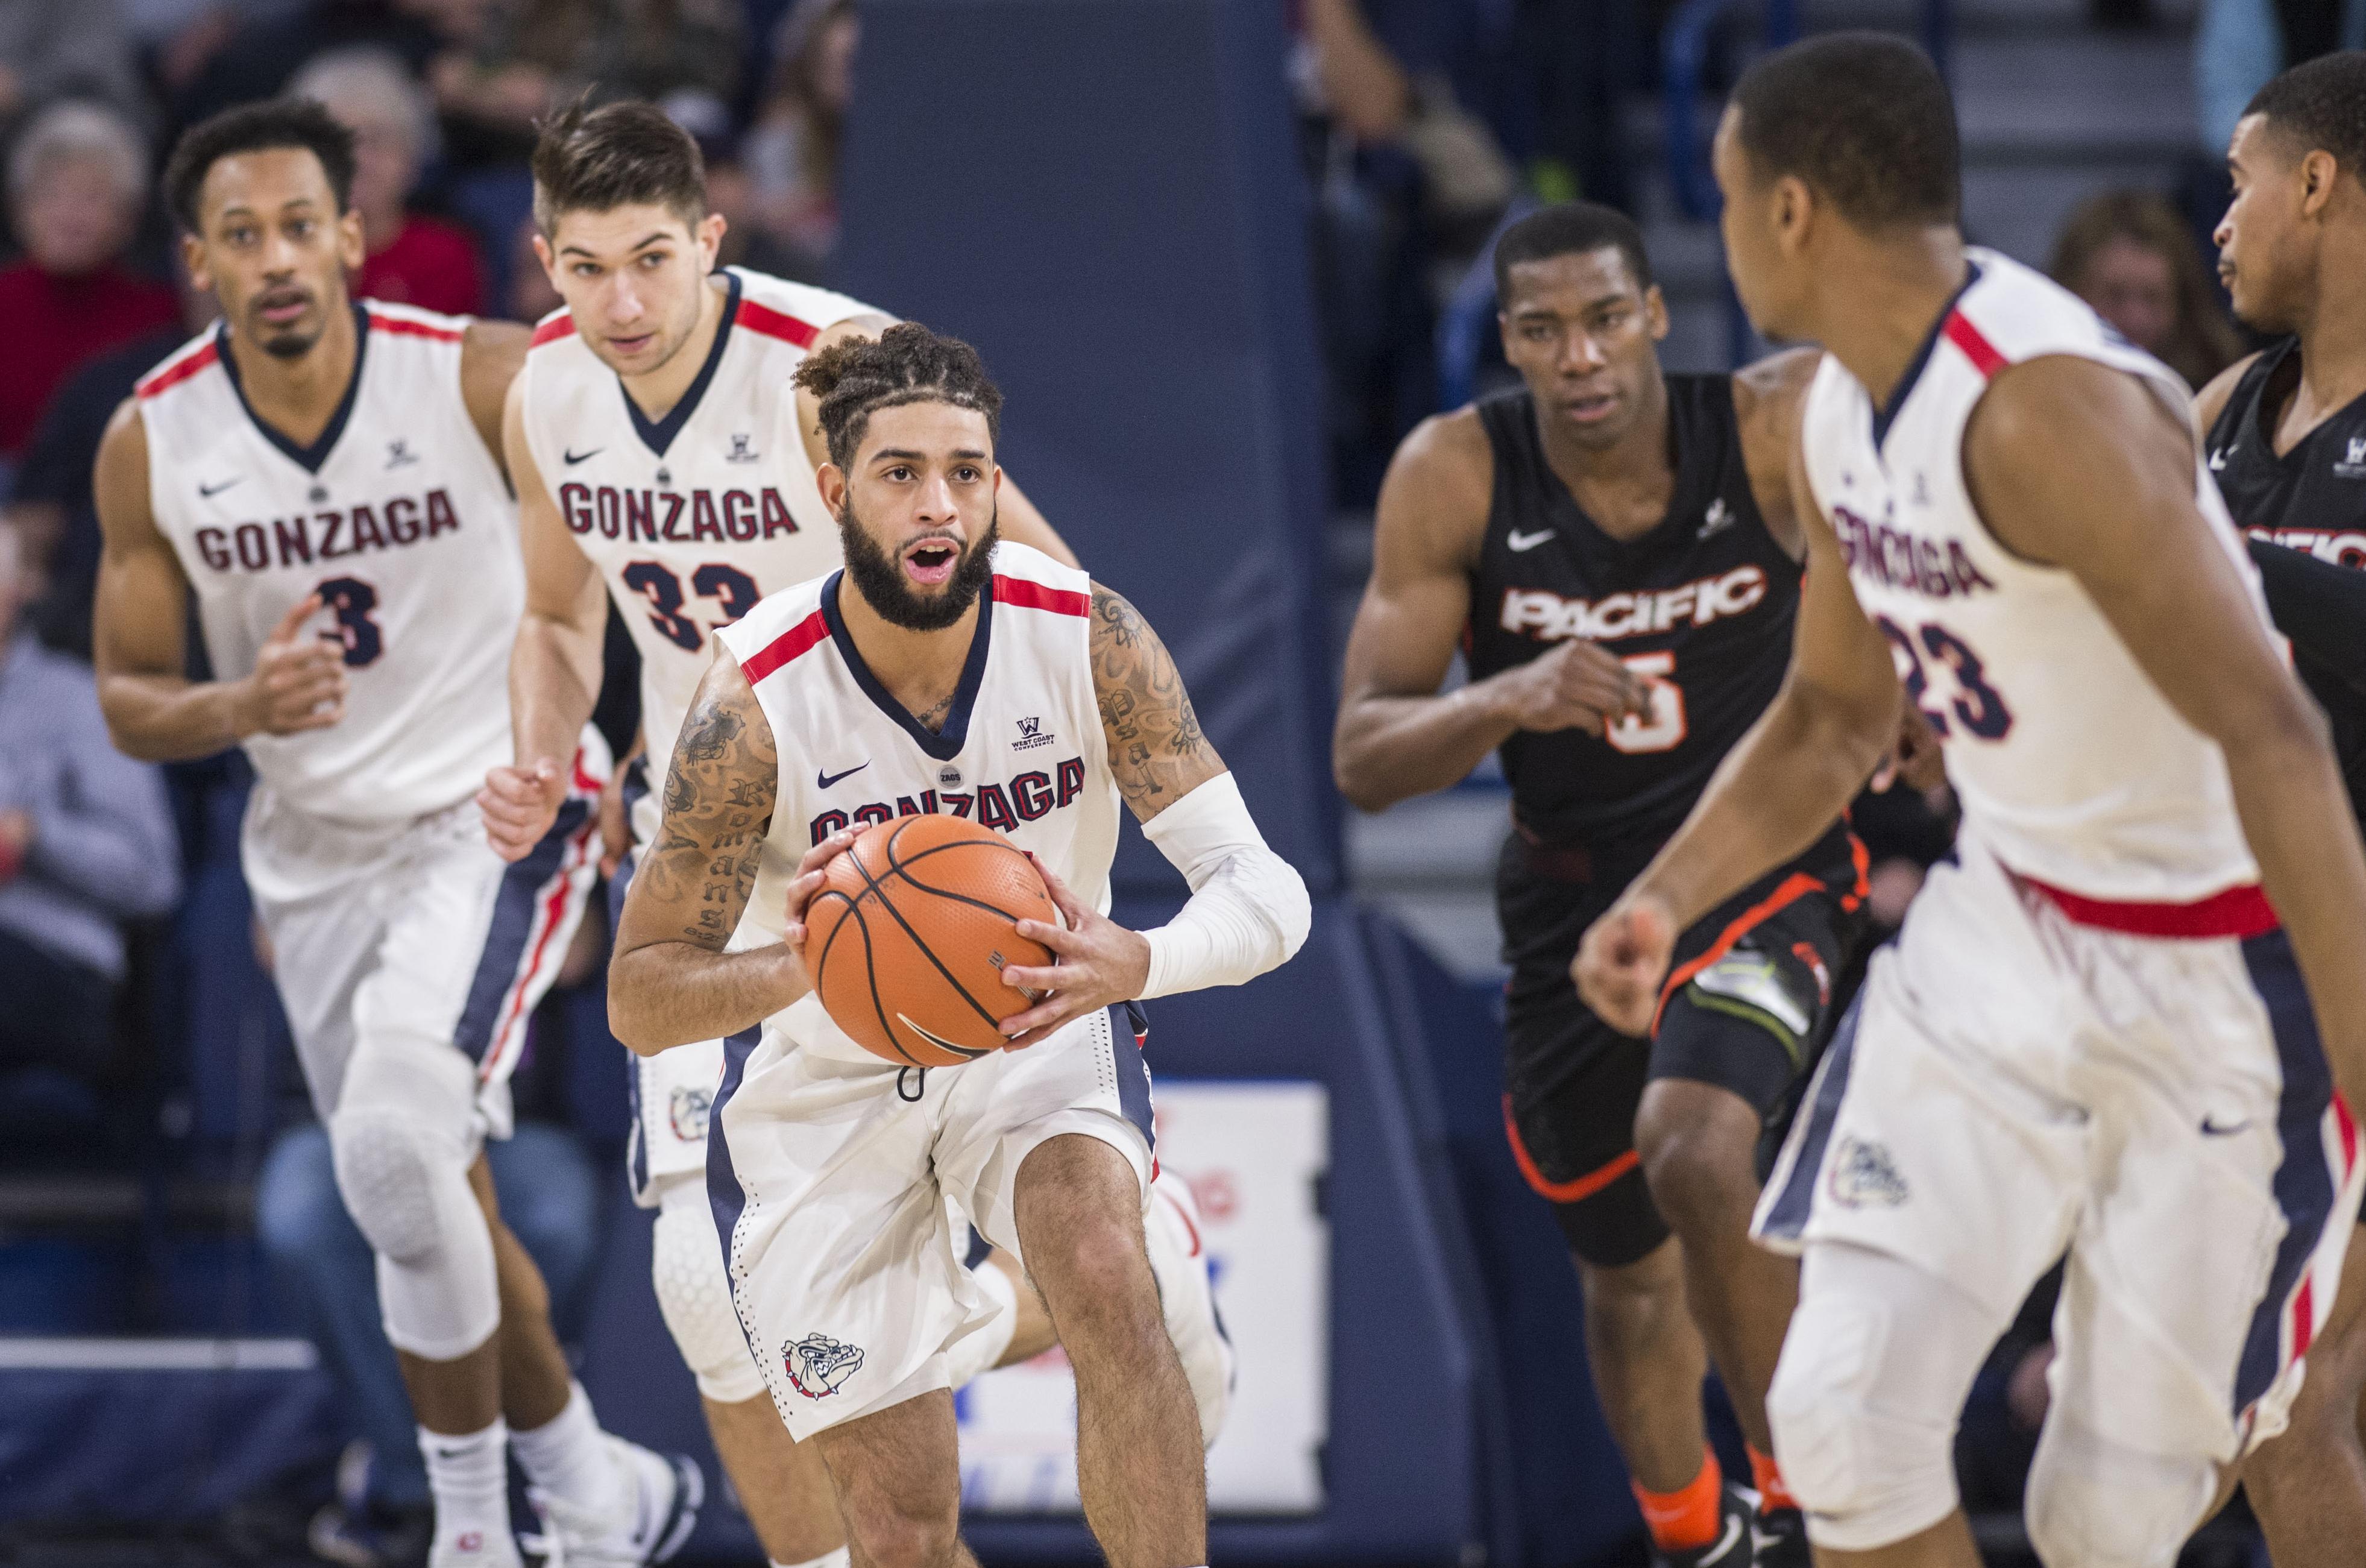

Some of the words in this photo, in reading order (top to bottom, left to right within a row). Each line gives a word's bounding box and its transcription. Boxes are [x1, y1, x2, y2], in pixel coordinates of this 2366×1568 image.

[195, 488, 460, 571] GONZAGA
[558, 483, 799, 542] GONZAGA
[317, 577, 386, 671] 3
[621, 561, 763, 656] 33
[1500, 564, 1767, 641] PACIFIC
[1605, 650, 1687, 754] 5
[940, 773, 961, 782] ZAGS
[1012, 739, 1031, 748] WEST
[1033, 734, 1055, 744] COAST
[1014, 740, 1054, 752] CONFERENCE
